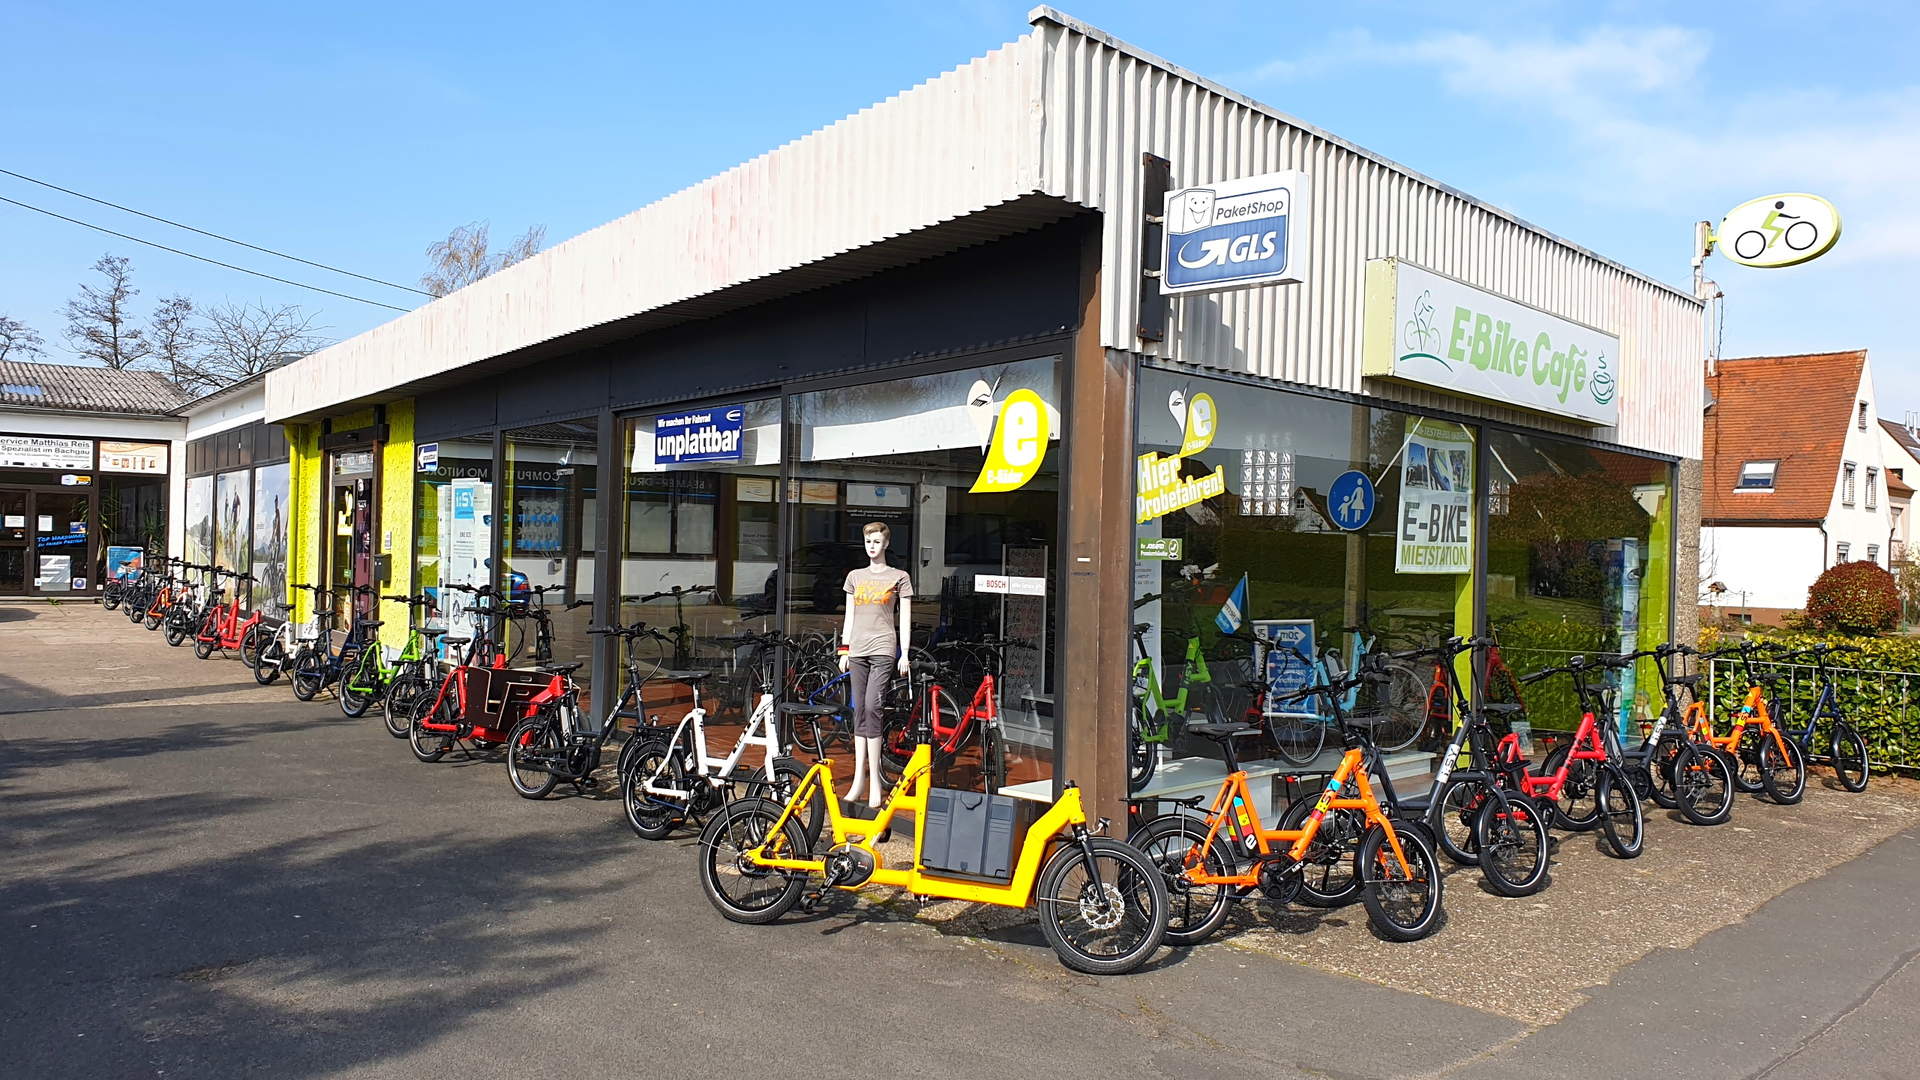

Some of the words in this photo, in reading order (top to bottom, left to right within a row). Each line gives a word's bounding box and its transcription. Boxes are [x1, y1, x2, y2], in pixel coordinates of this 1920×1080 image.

[1216, 200, 1284, 220] PaketShop
[1229, 231, 1277, 263] GLS
[1447, 306, 1529, 377] E-Bike
[657, 419, 666, 428] Wir
[666, 417, 685, 427] machen
[692, 413, 711, 424] Fahrrad
[1, 445, 41, 453] Spezialist
[31, 438, 69, 447] Matthias
[71, 440, 90, 448] Reis
[1137, 455, 1181, 493] Hier
[1136, 466, 1224, 521] Probefahren!
[1402, 501, 1468, 543] E-BIKE
[1401, 544, 1468, 566] MIETSTATION
[986, 579, 1007, 589] BOSCH
